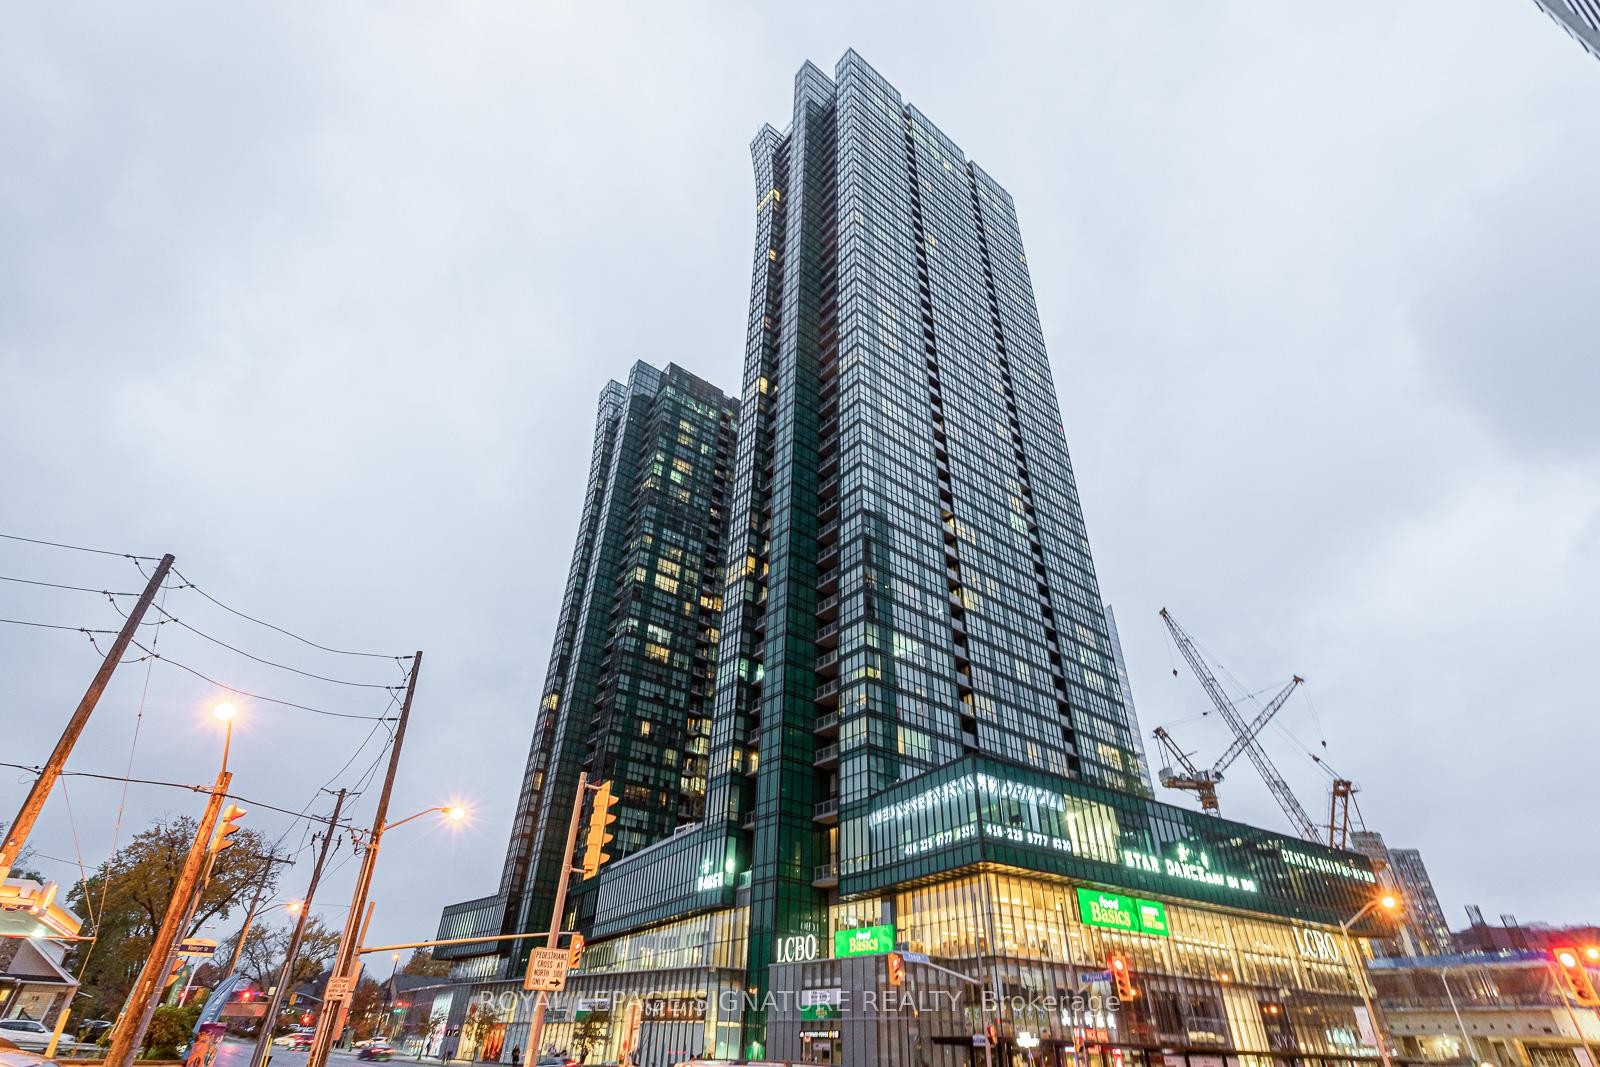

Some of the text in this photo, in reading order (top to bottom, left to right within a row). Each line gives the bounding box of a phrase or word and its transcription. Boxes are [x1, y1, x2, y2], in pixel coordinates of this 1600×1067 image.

[1089, 901, 1131, 928] Basics
[776, 933, 817, 963] LCBO
[848, 937, 879, 953] Basics
[1292, 926, 1339, 961] LCBO
[535, 951, 567, 961] PEDESTRIANS
[537, 960, 553, 968] CROSS
[534, 968, 564, 978] NORTH SIDE
[531, 977, 546, 986] ONLY
